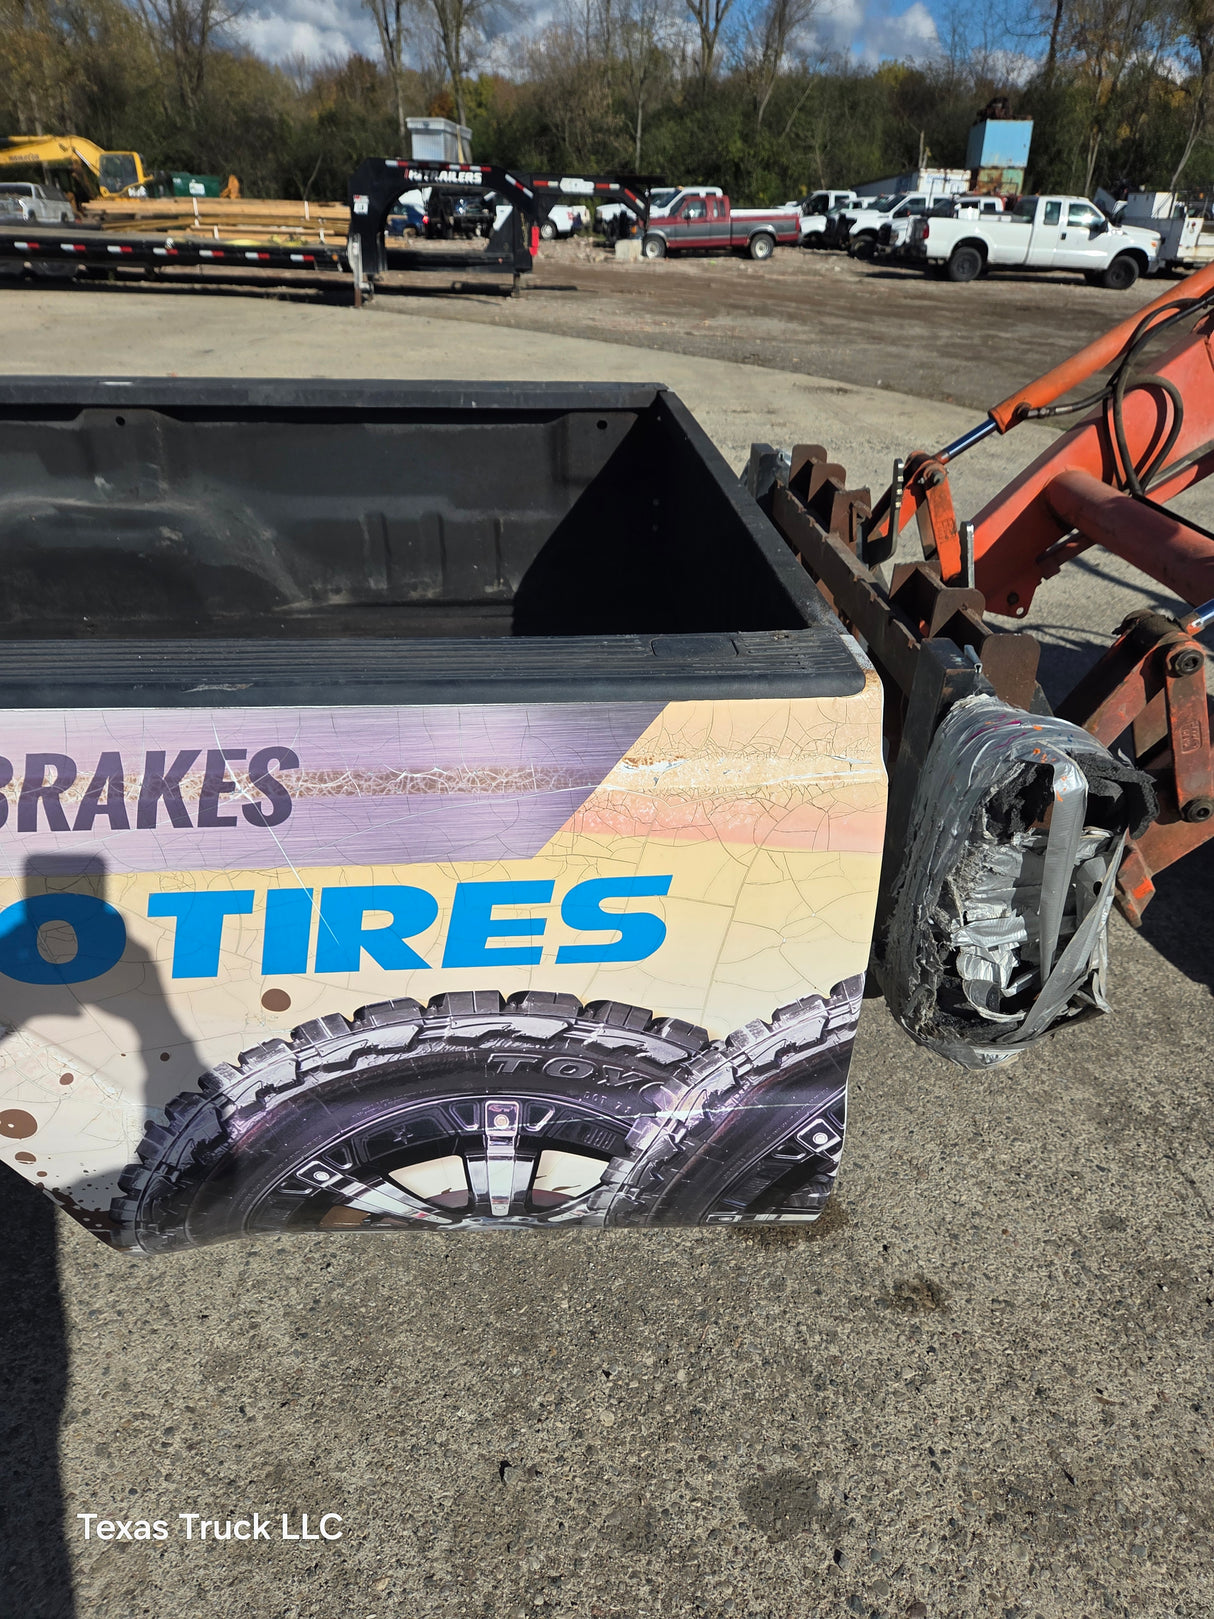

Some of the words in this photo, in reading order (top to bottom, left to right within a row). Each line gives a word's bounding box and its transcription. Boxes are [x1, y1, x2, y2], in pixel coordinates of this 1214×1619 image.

[0, 746, 300, 832] RAKES
[0, 893, 126, 985] O
[147, 874, 673, 979] TIRES
